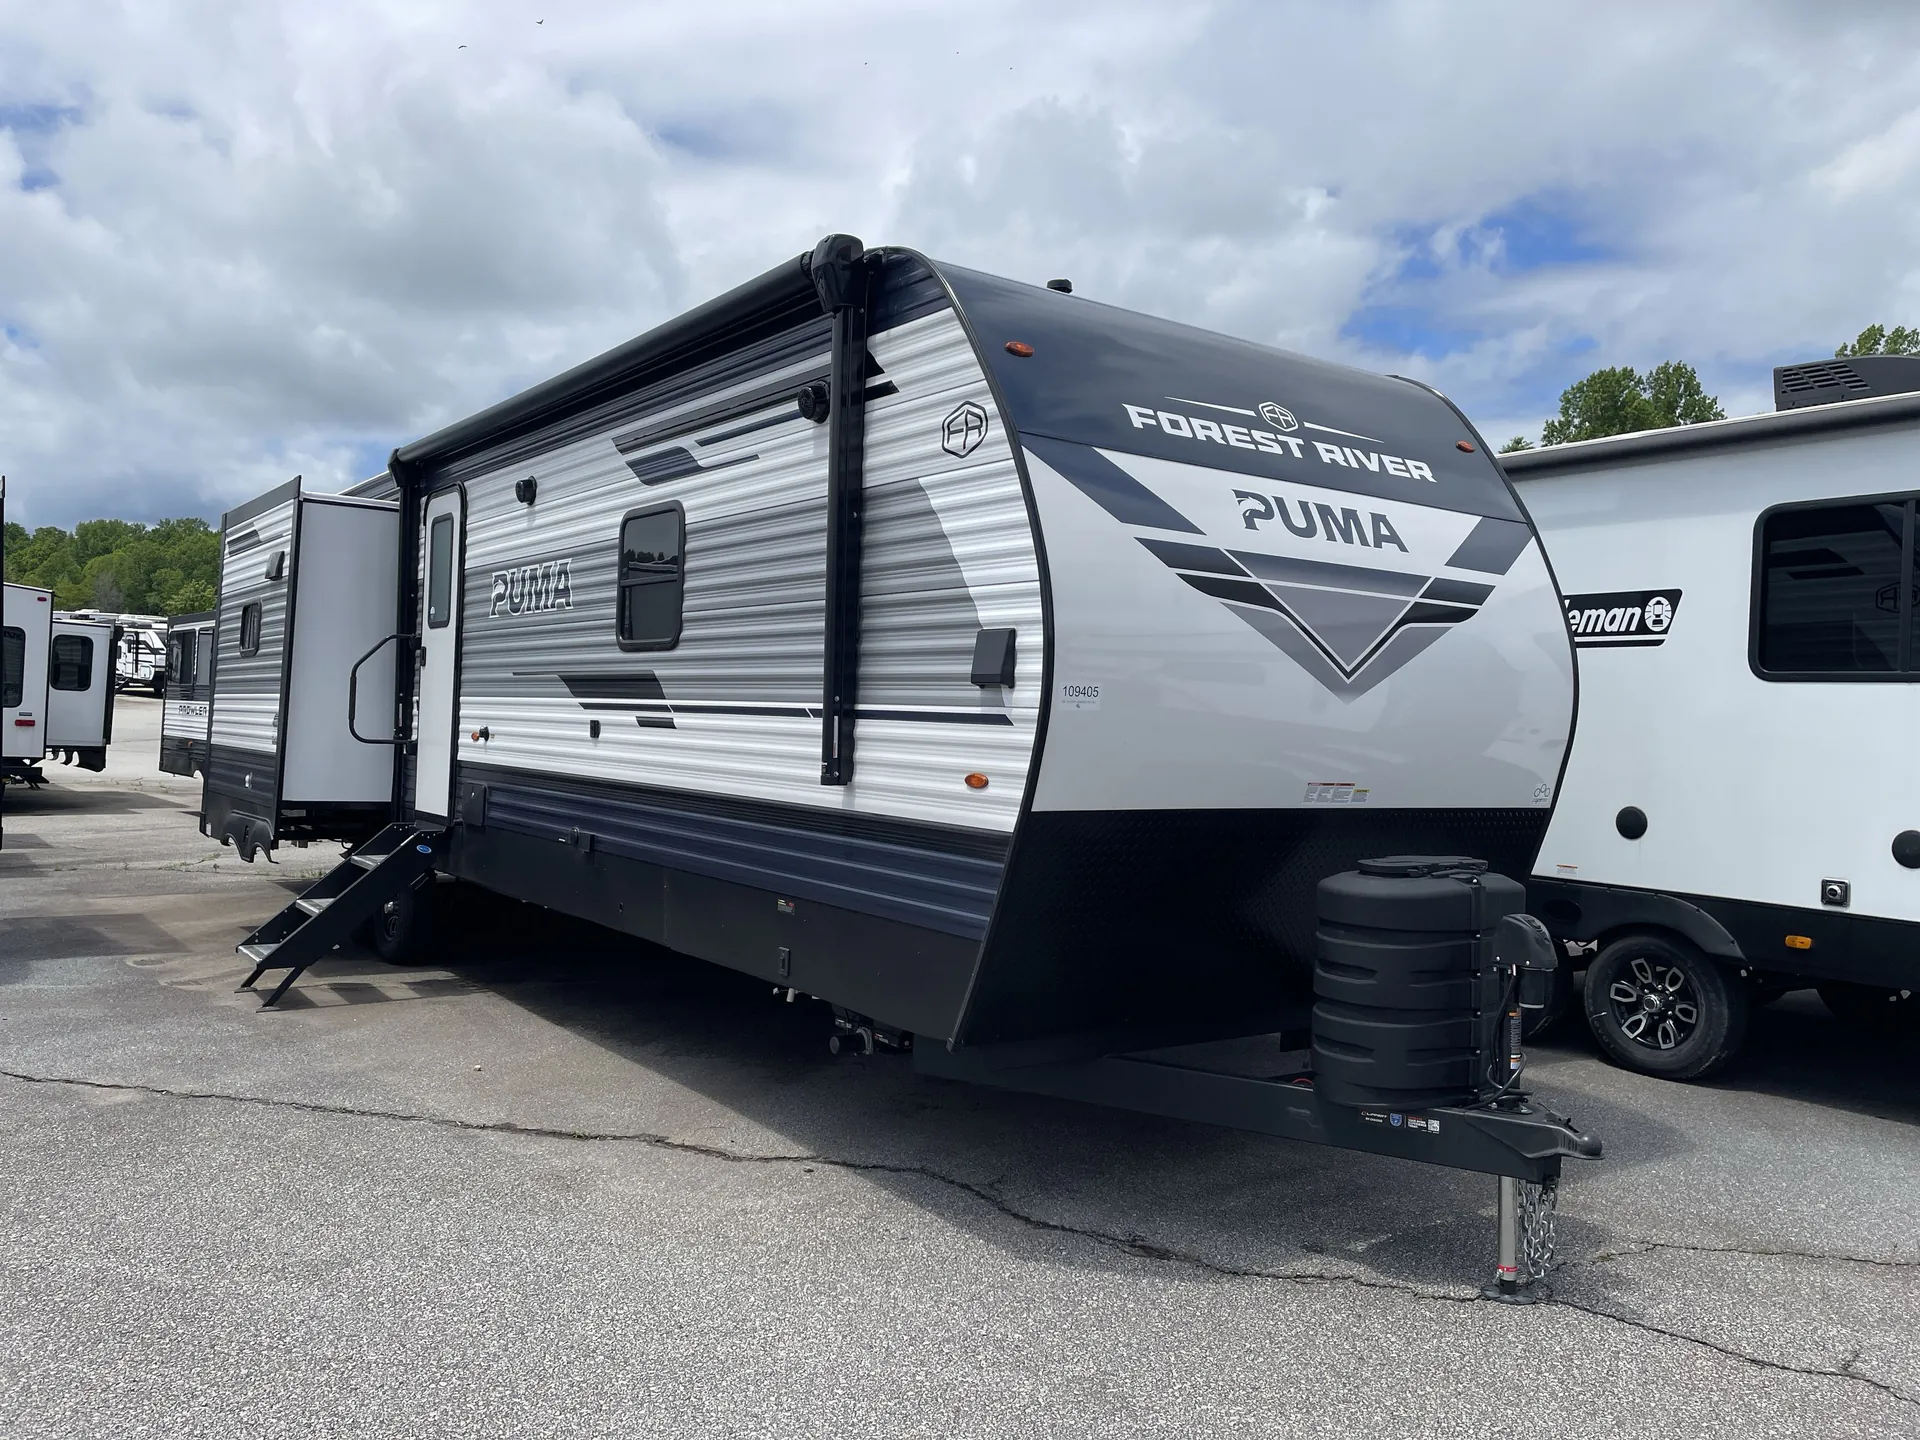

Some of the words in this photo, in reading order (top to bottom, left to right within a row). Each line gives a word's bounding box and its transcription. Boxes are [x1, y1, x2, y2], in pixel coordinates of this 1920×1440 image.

[1121, 403, 1305, 459] FOREST
[1311, 440, 1438, 483] RIVER
[1231, 488, 1410, 554] PUMA
[489, 558, 574, 619] PUMA
[1564, 599, 1642, 633] eman
[179, 705, 207, 716] PROWLER
[1062, 685, 1099, 698] 109405
